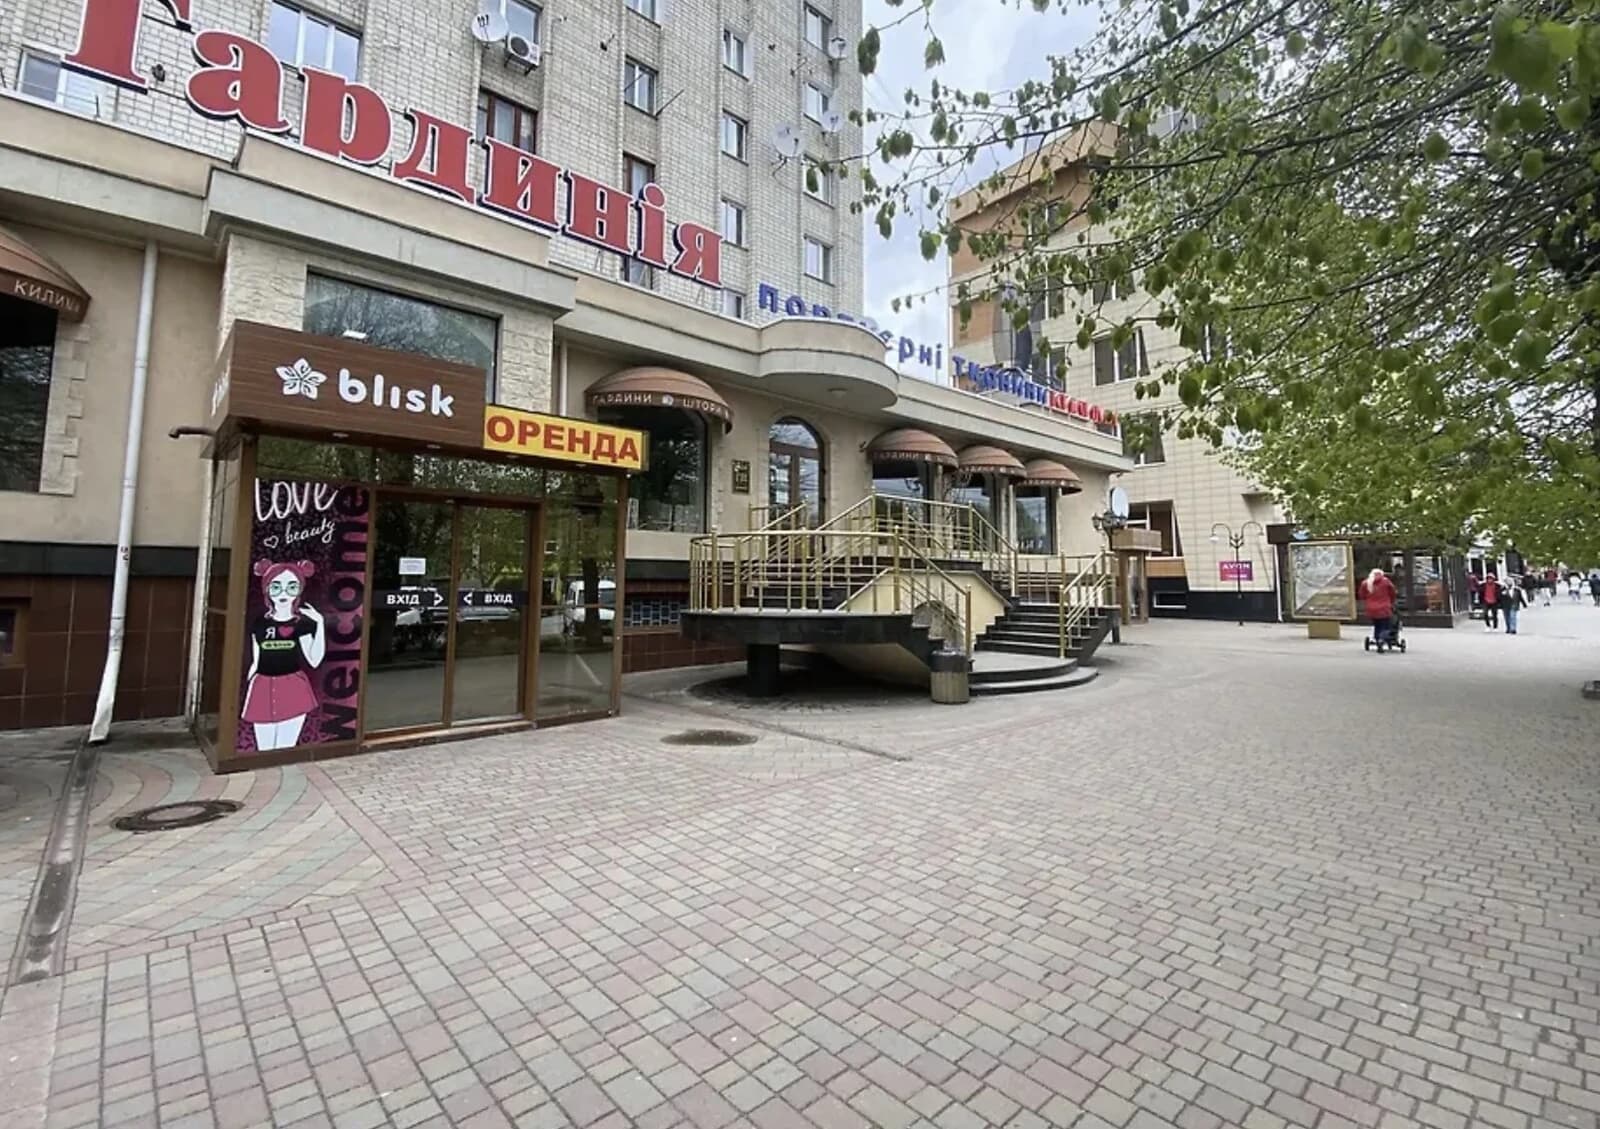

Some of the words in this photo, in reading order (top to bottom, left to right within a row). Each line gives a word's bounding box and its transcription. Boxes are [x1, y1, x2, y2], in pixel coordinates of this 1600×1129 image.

[61, 0, 723, 289] Гардинія
[486, 415, 641, 464] ОРЕНДА
[285, 517, 336, 544] beauty
[386, 593, 420, 605] ВХІД
[483, 593, 514, 605] ВХІД
[265, 626, 277, 640] Я
